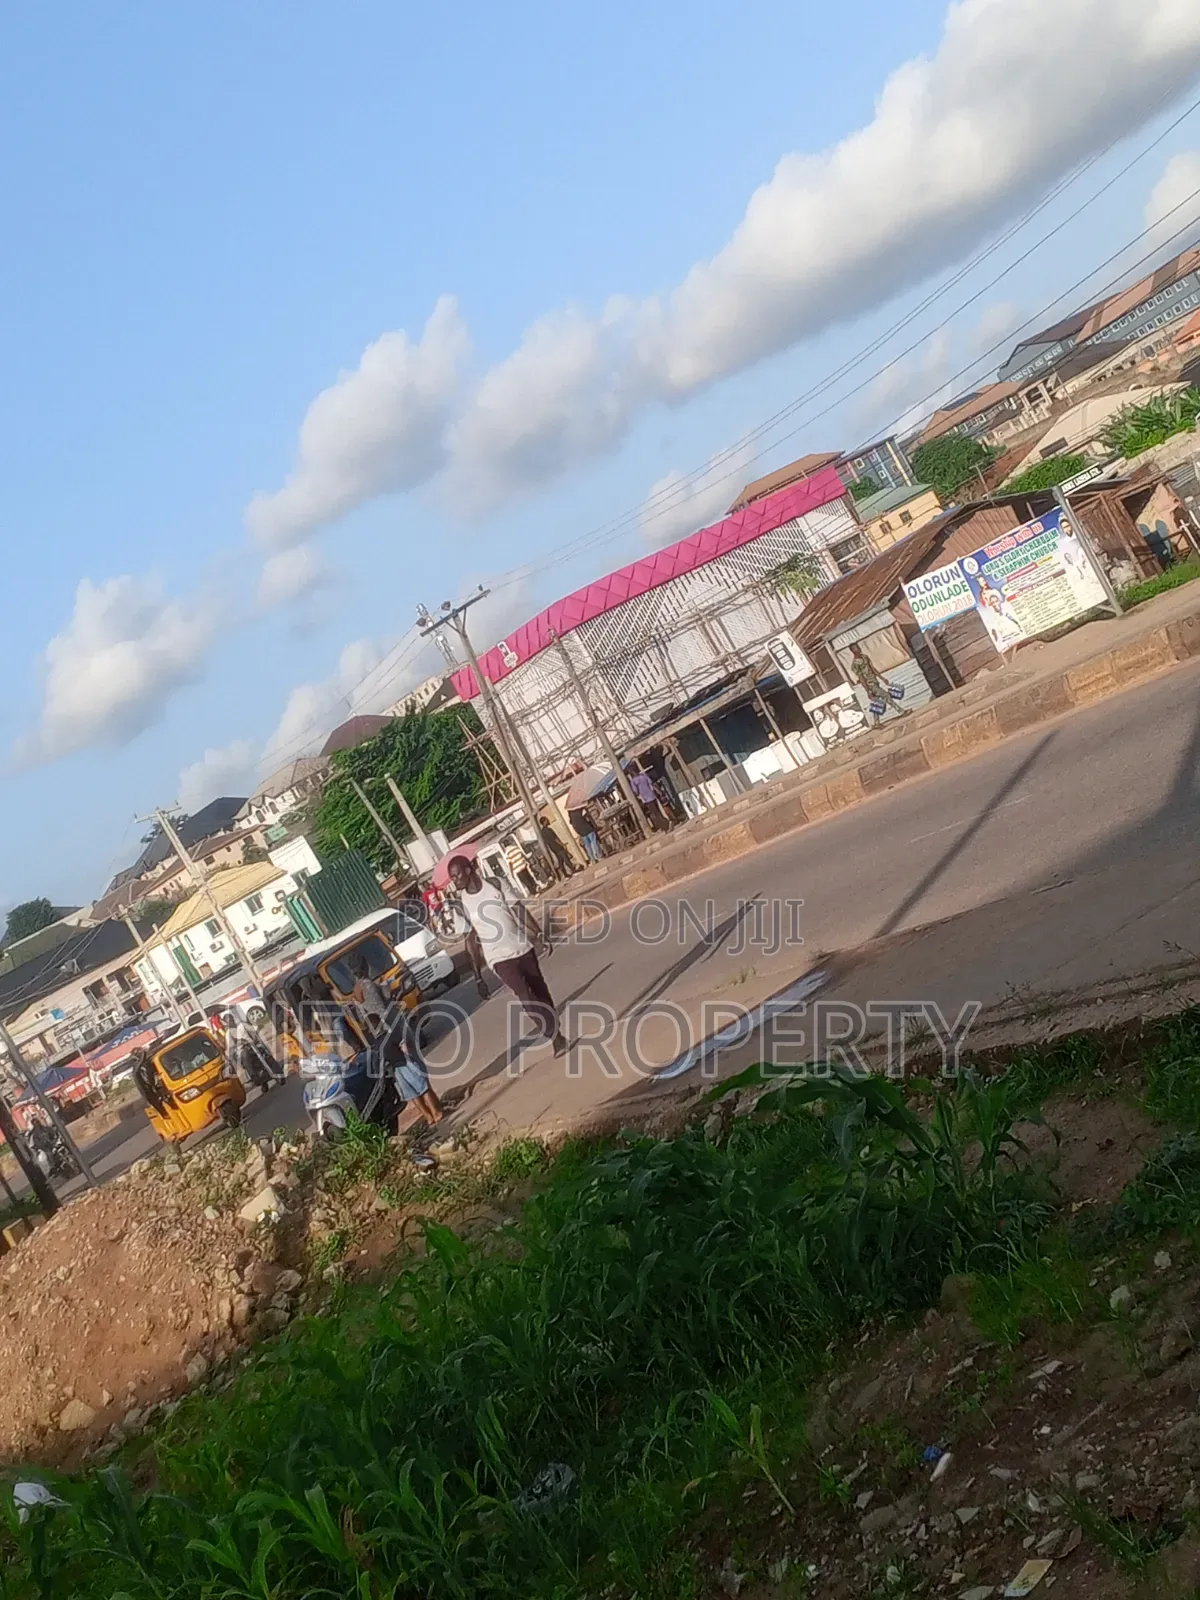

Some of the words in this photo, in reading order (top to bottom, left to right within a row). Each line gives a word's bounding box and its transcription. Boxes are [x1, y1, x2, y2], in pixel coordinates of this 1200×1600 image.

[1029, 541, 1058, 560] CHURCH
[908, 566, 961, 598] OLORUN
[912, 580, 969, 613] ODUNLADE
